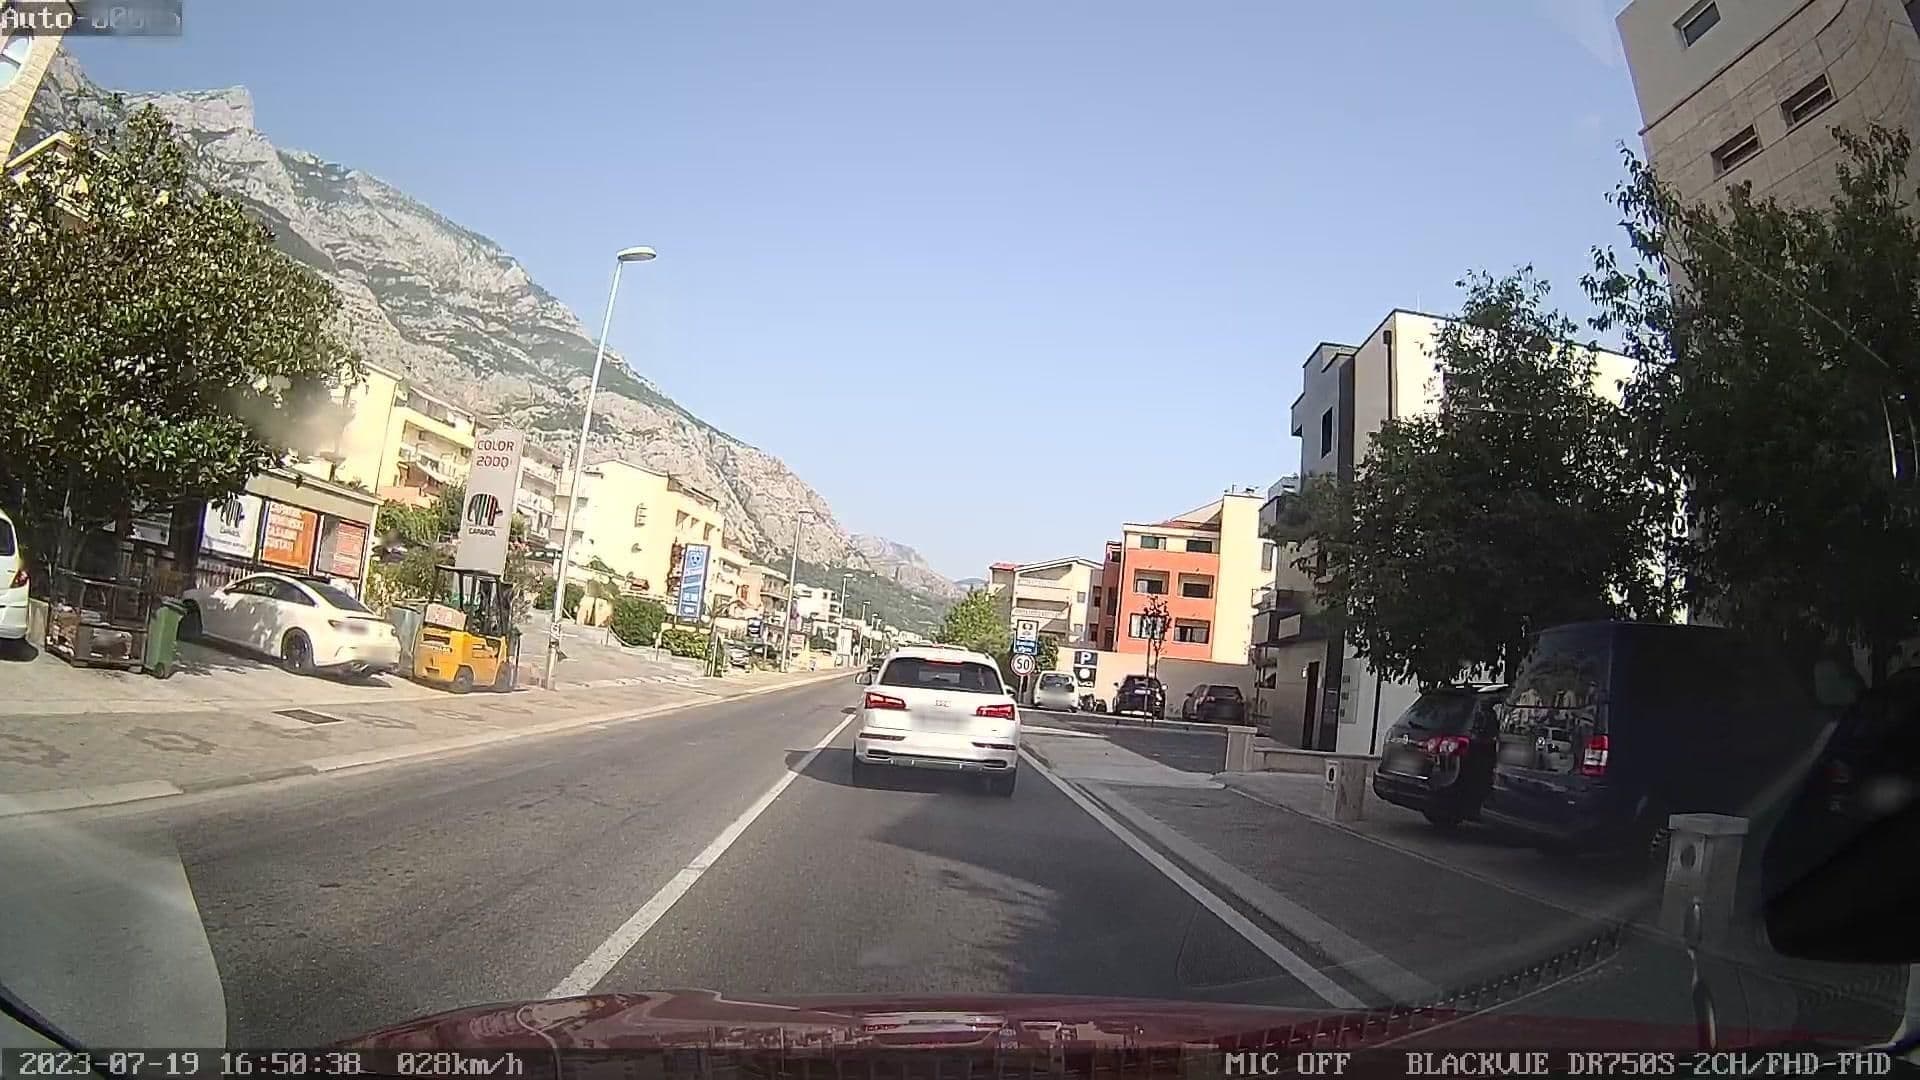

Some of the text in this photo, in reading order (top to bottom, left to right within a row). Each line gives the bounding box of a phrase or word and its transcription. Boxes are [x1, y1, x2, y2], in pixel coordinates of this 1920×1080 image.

[477, 440, 515, 452] COLOR
[476, 456, 509, 468] 2000
[1080, 650, 1092, 664] P
[1016, 658, 1030, 670] 50
